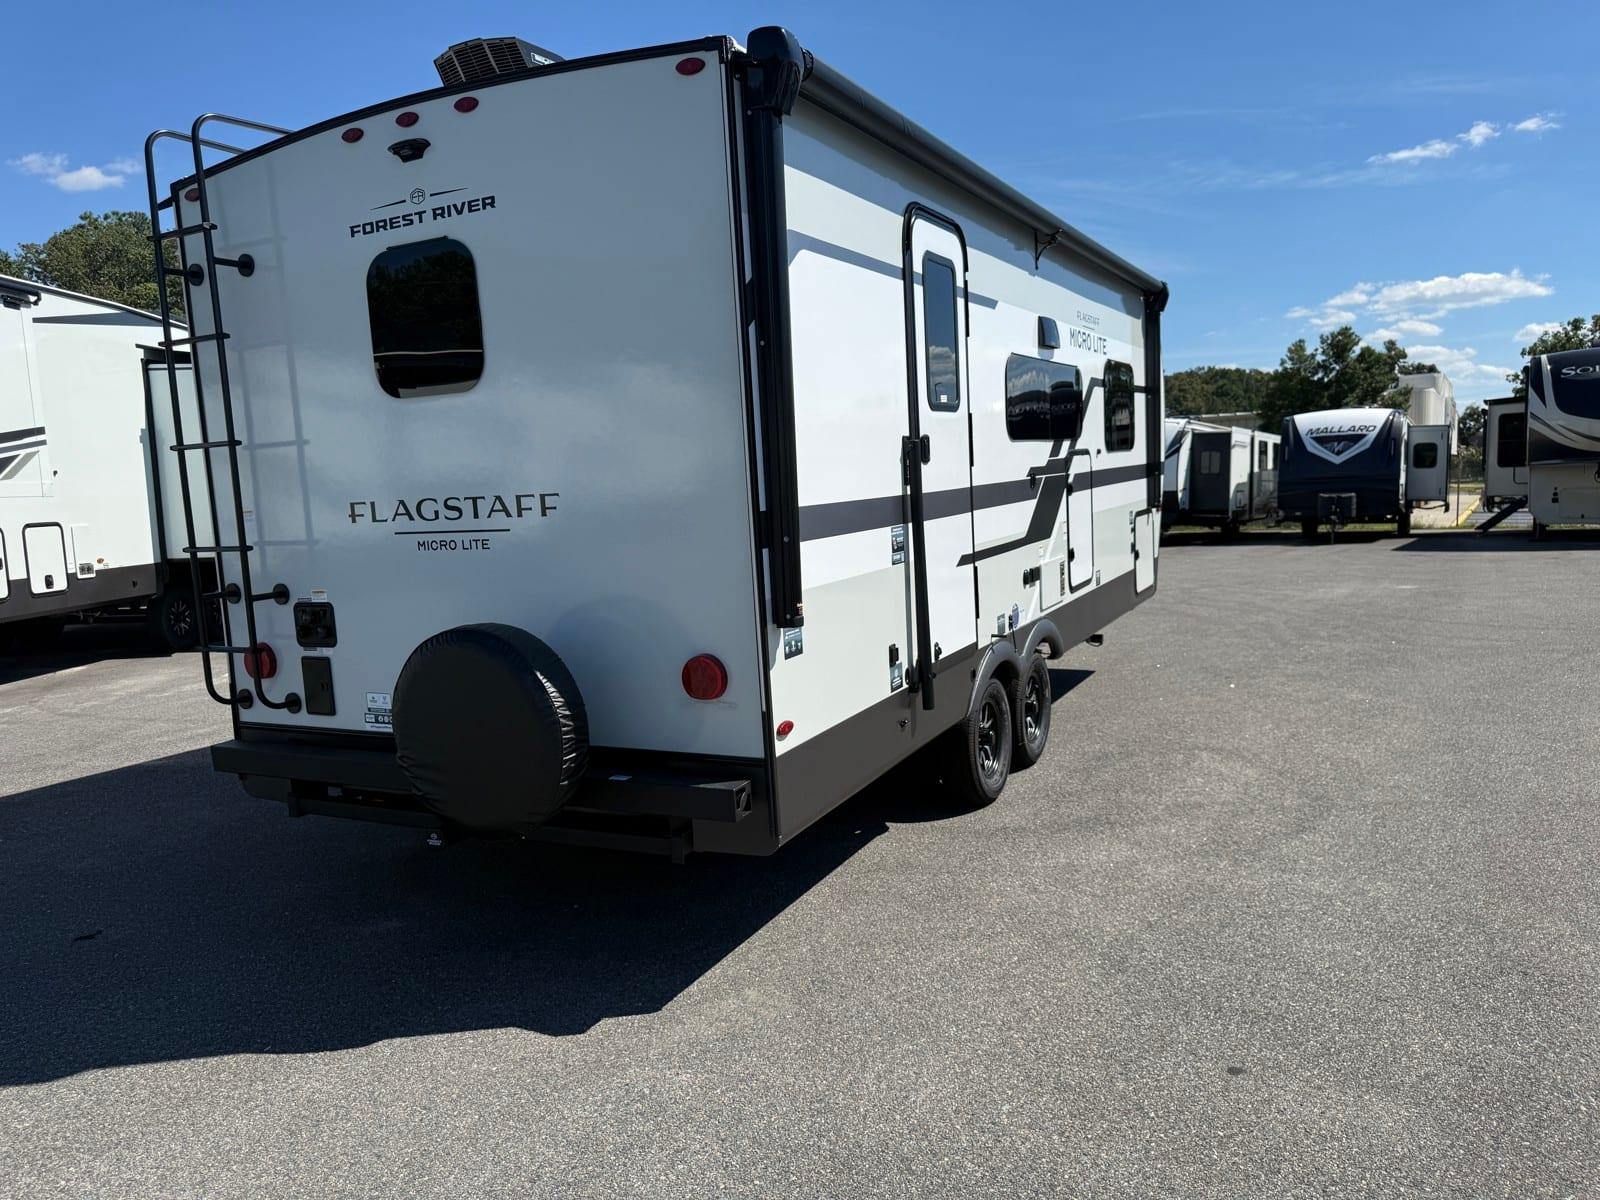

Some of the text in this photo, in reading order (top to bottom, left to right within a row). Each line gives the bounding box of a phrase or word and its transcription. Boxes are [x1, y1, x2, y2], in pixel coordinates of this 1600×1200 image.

[349, 195, 496, 238] FOREST RIVER
[1070, 327, 1108, 356] MICRO LITE
[1305, 424, 1377, 437] MALLARD
[348, 492, 560, 524] FLAGSTAFF
[417, 538, 490, 551] MICRO LITE
